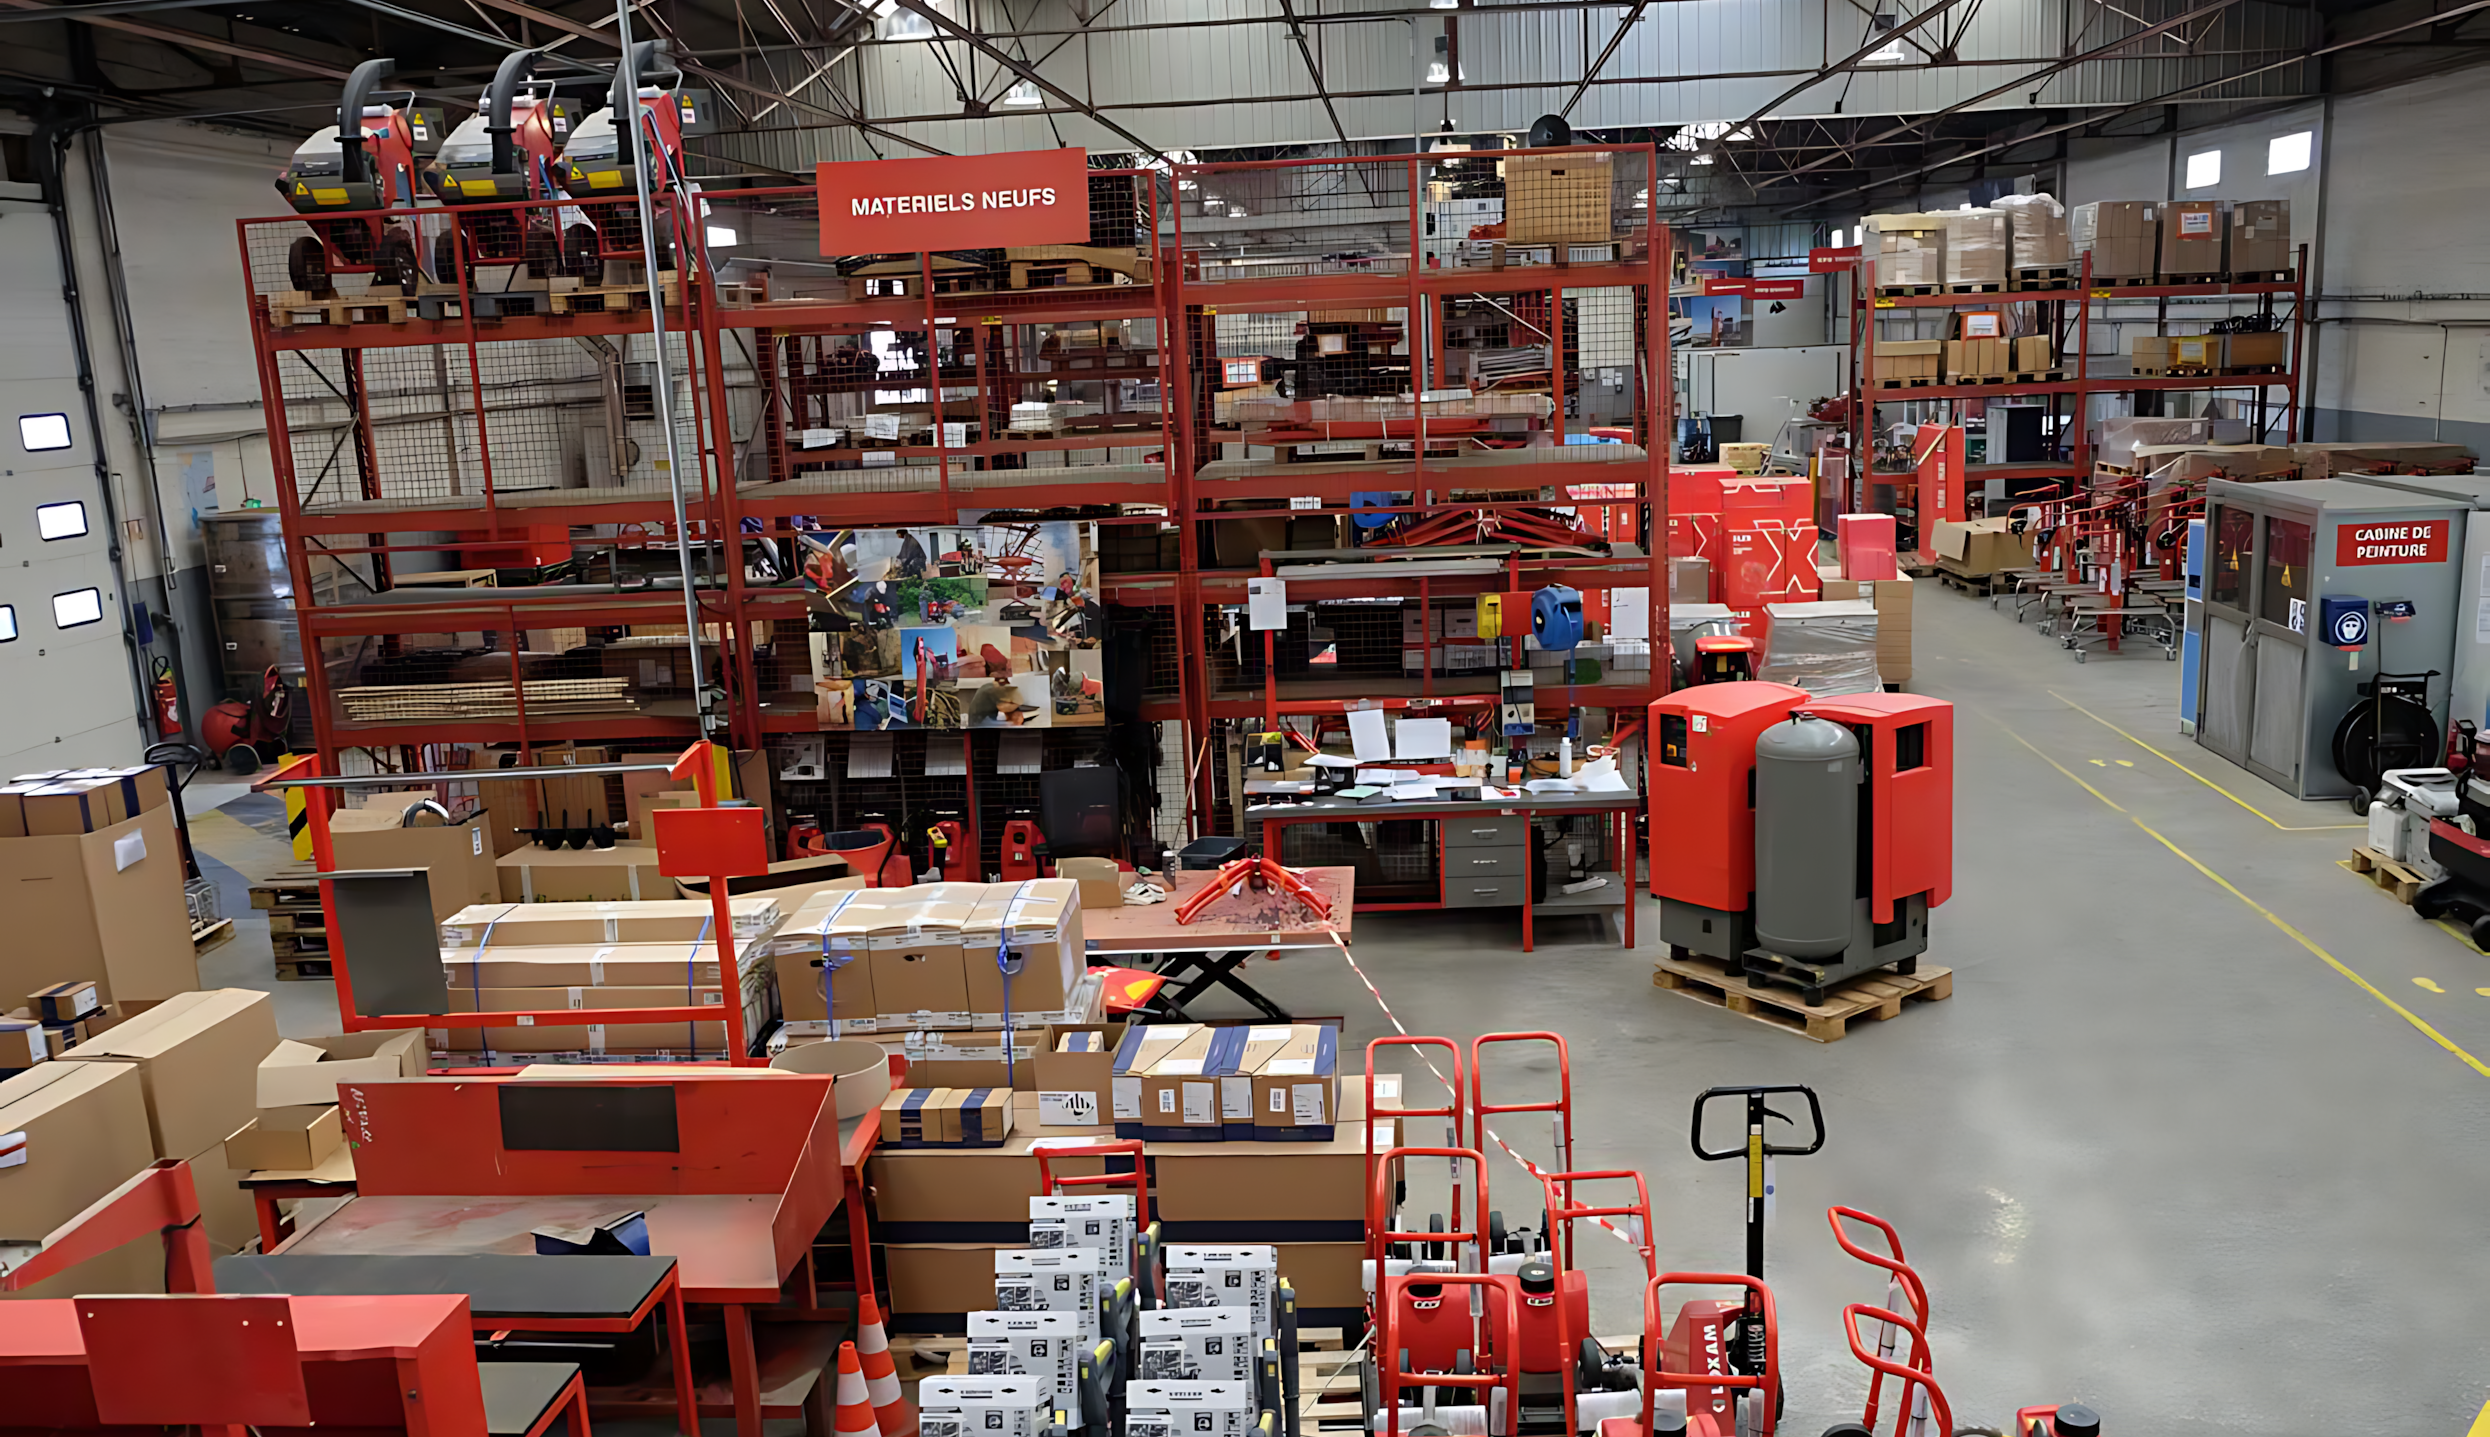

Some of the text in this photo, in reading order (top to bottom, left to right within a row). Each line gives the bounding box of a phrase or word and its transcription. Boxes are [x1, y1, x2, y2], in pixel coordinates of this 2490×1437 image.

[851, 187, 1056, 217] MATERIELS NEUFS
[2412, 526, 2432, 539] DE
[2356, 543, 2428, 559] PEINTURE
